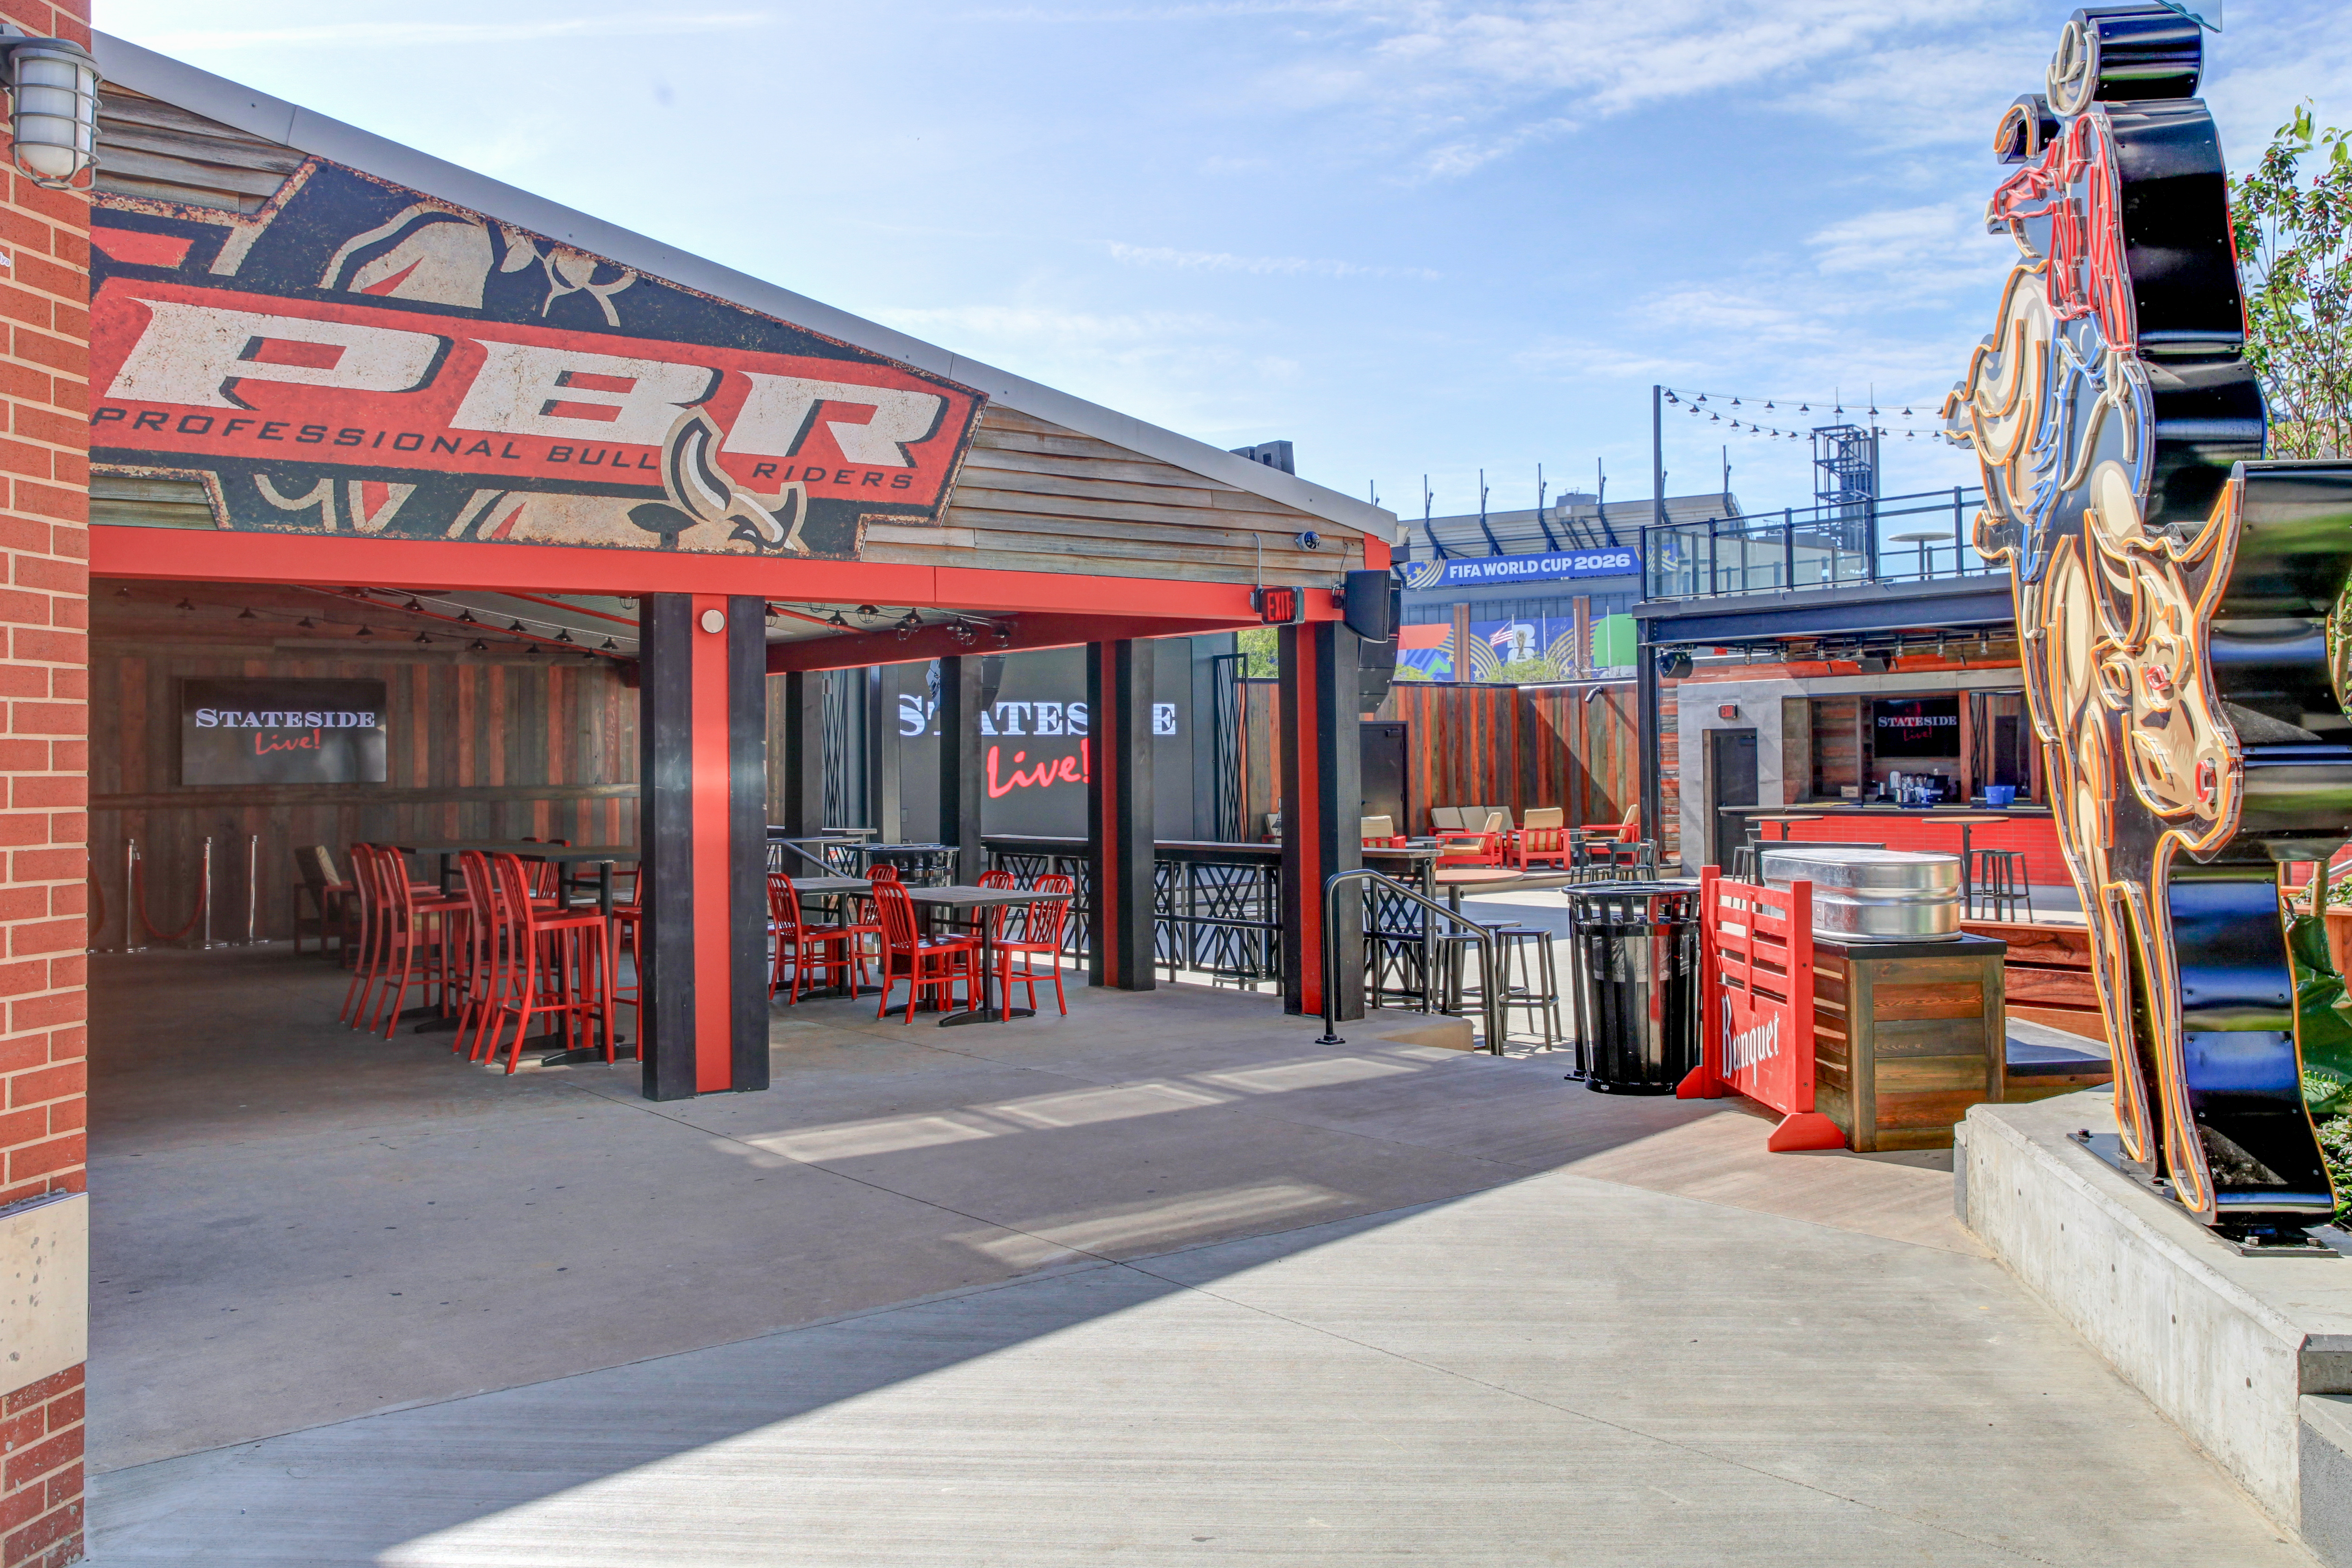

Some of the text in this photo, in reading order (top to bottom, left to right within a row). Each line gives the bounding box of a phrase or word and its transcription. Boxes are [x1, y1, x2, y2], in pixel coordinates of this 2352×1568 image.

[104, 296, 946, 468] PBR
[90, 407, 913, 489] PROFESSIONAL BULL RIDERS
[1450, 553, 1630, 578] FIFA WORLD CUP 2026
[1267, 591, 1291, 621] EXIT
[196, 709, 375, 728] STATESIDE
[1878, 716, 1957, 727] STATESIDE
[256, 729, 320, 755] Live!
[986, 737, 1090, 799] Live!
[1721, 994, 1780, 1088] Banquet
